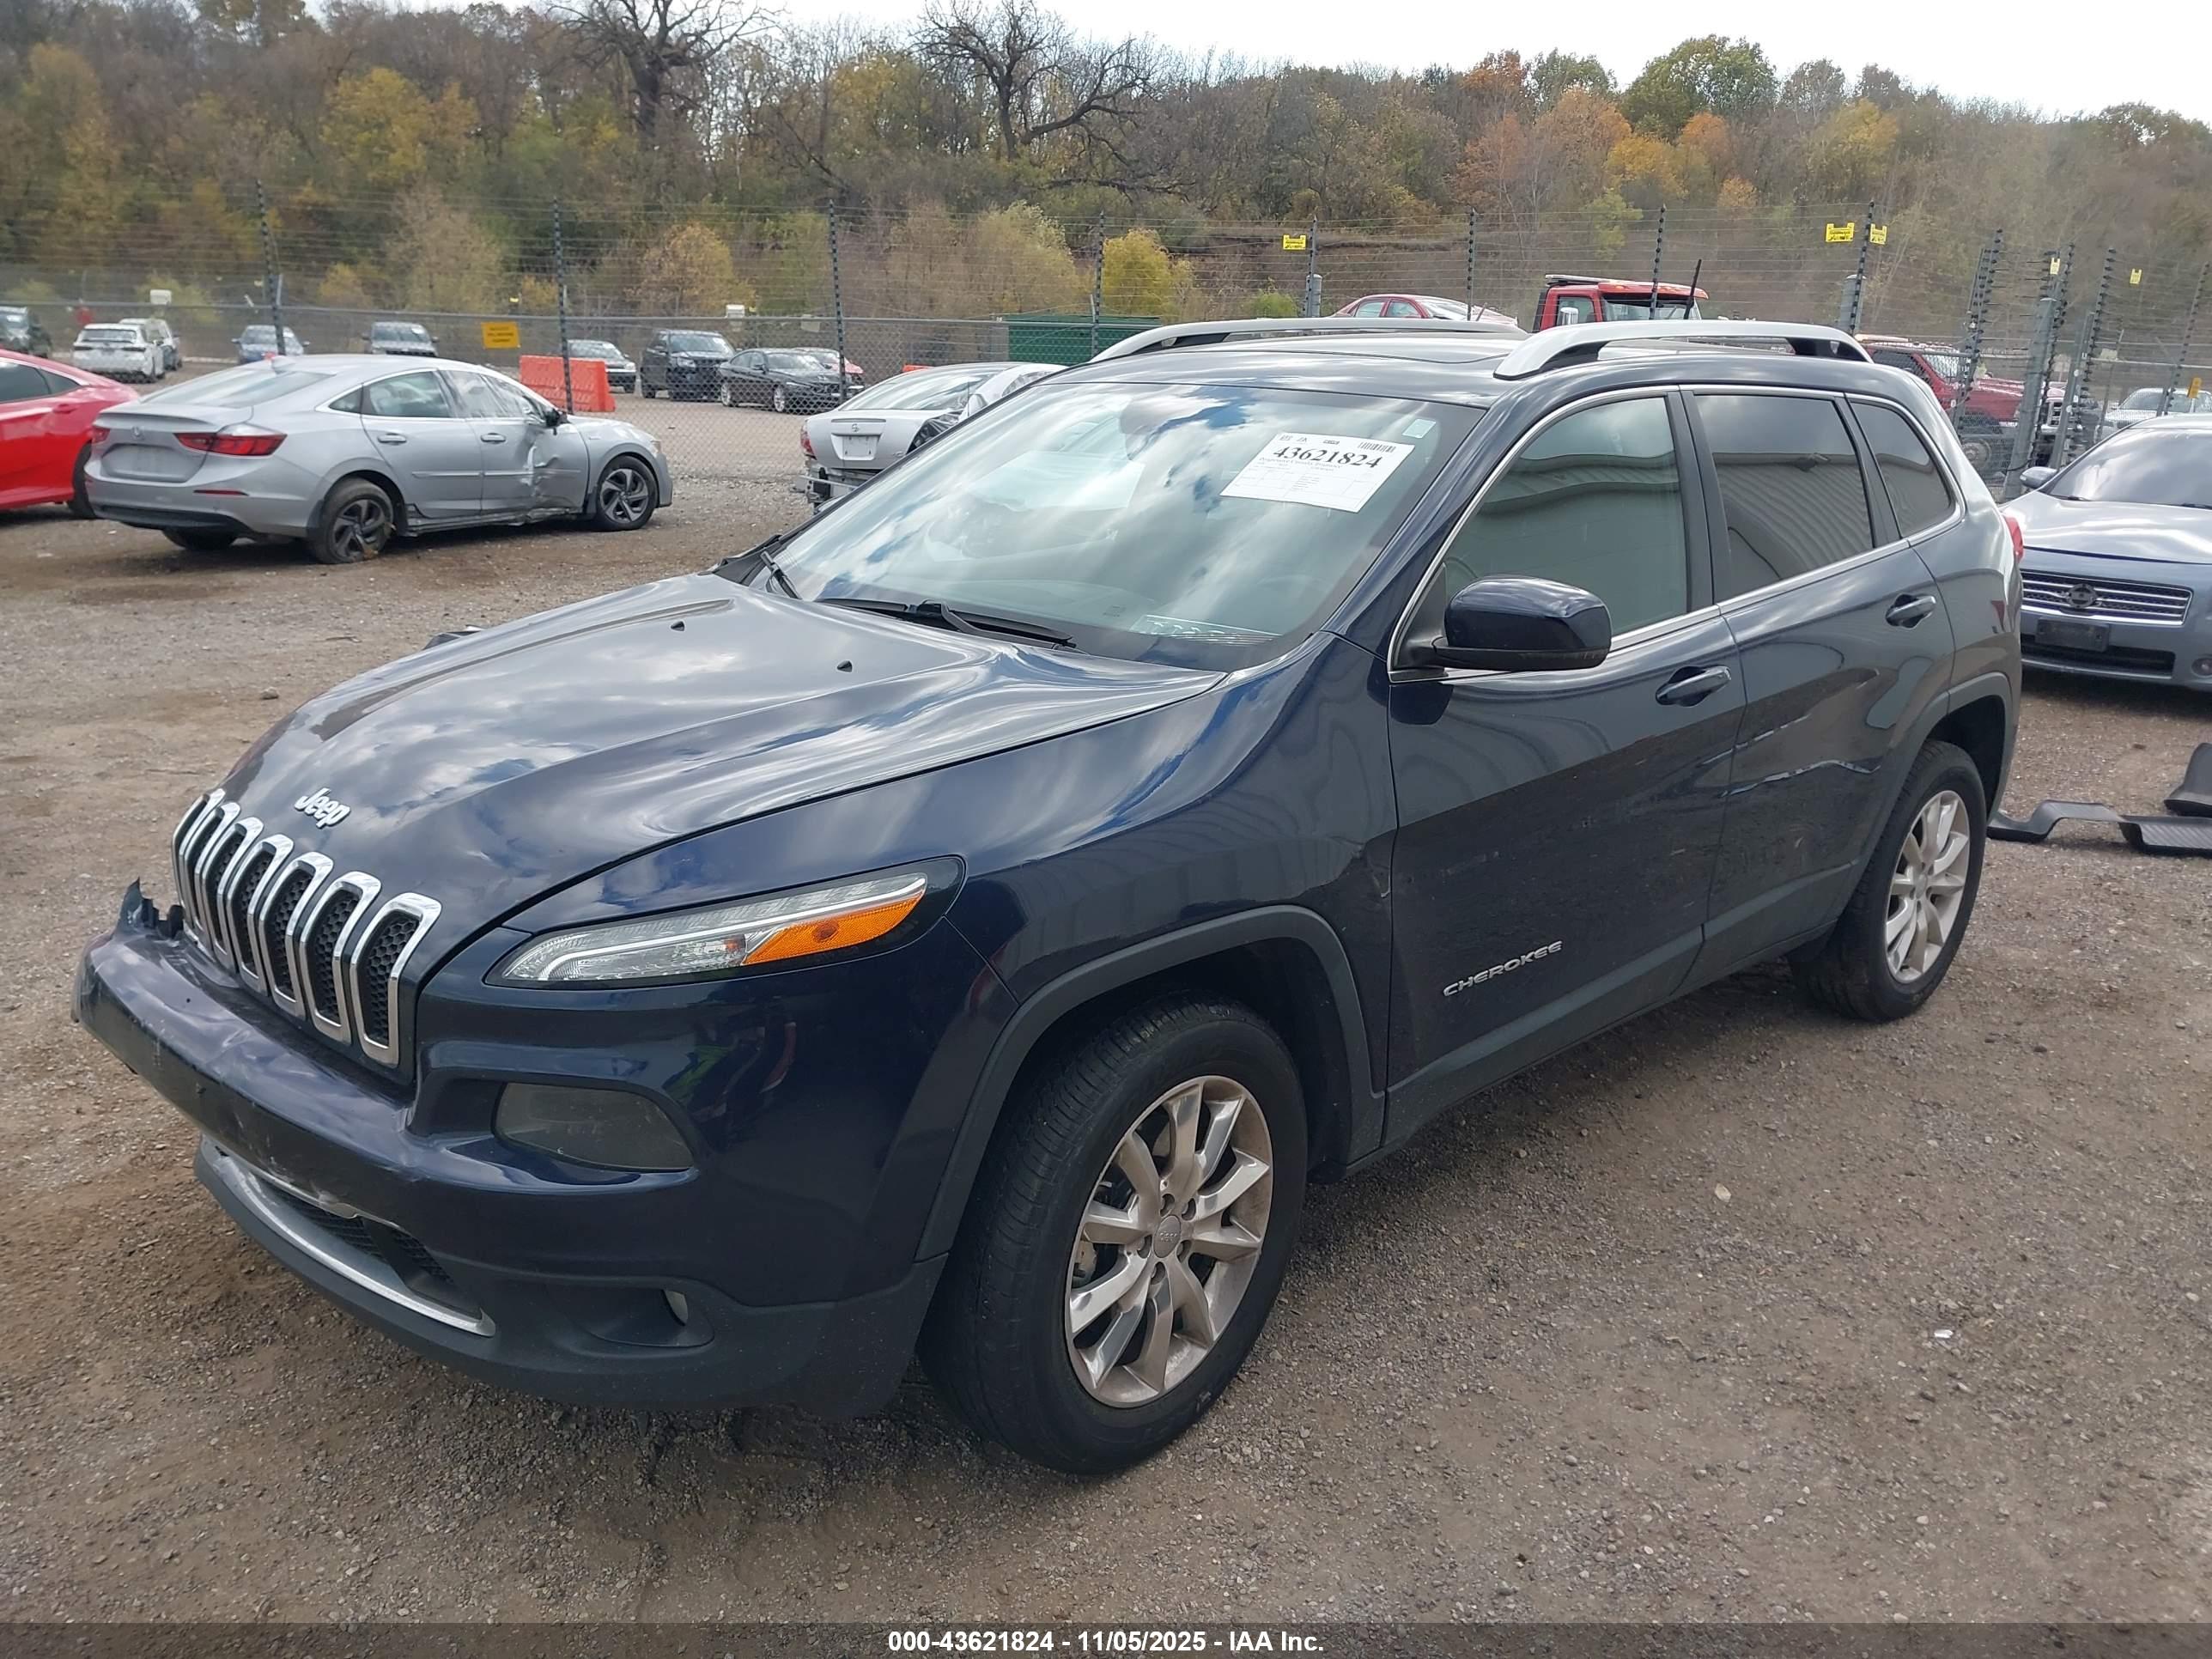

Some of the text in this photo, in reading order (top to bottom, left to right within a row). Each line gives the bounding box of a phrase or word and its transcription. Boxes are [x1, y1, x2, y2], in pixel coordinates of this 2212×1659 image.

[1273, 446, 1382, 468] 43621824
[295, 787, 350, 829] Jeep
[1443, 940, 1563, 997] CHEROKEE
